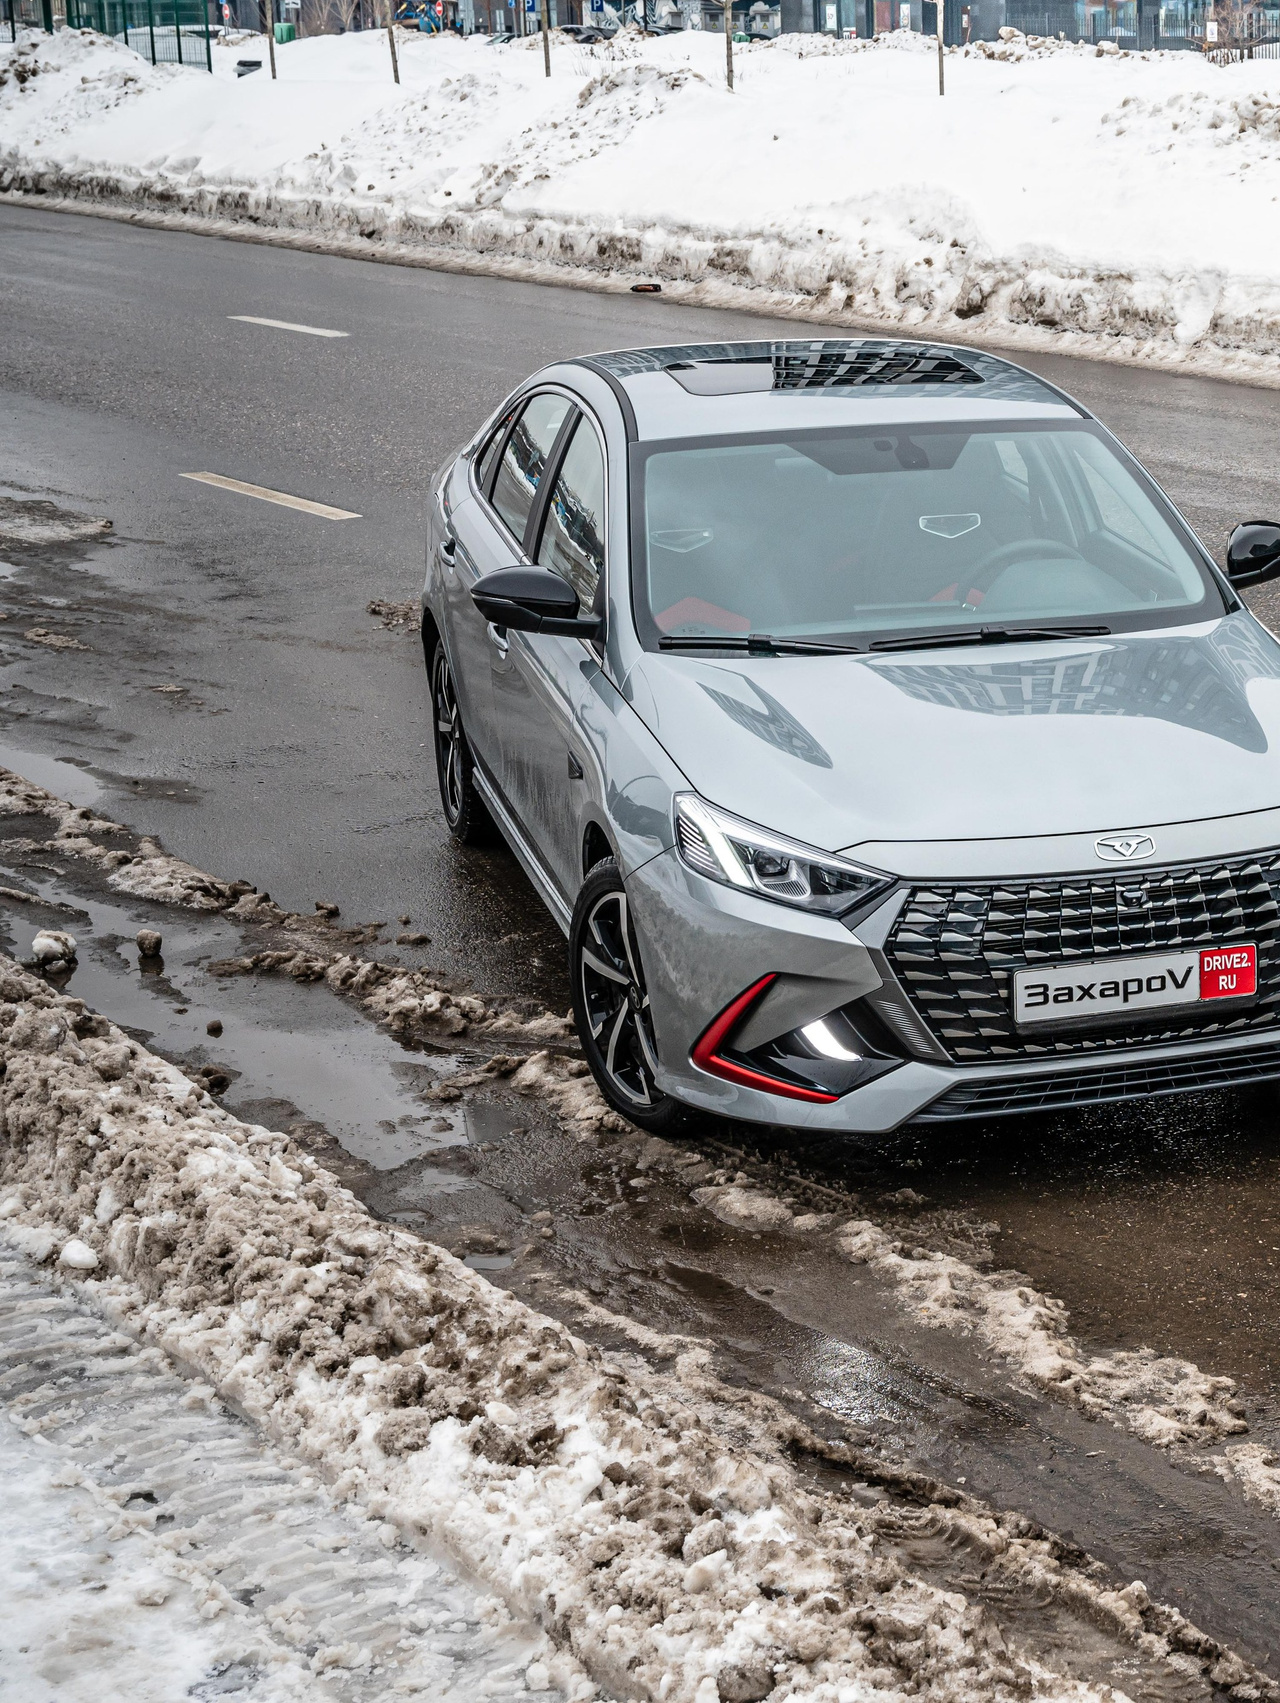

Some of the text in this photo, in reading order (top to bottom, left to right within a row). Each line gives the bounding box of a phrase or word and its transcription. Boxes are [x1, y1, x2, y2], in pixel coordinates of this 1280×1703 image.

[525, 0, 533, 11] P
[594, 0, 601, 11] P
[1218, 974, 1237, 991] RU
